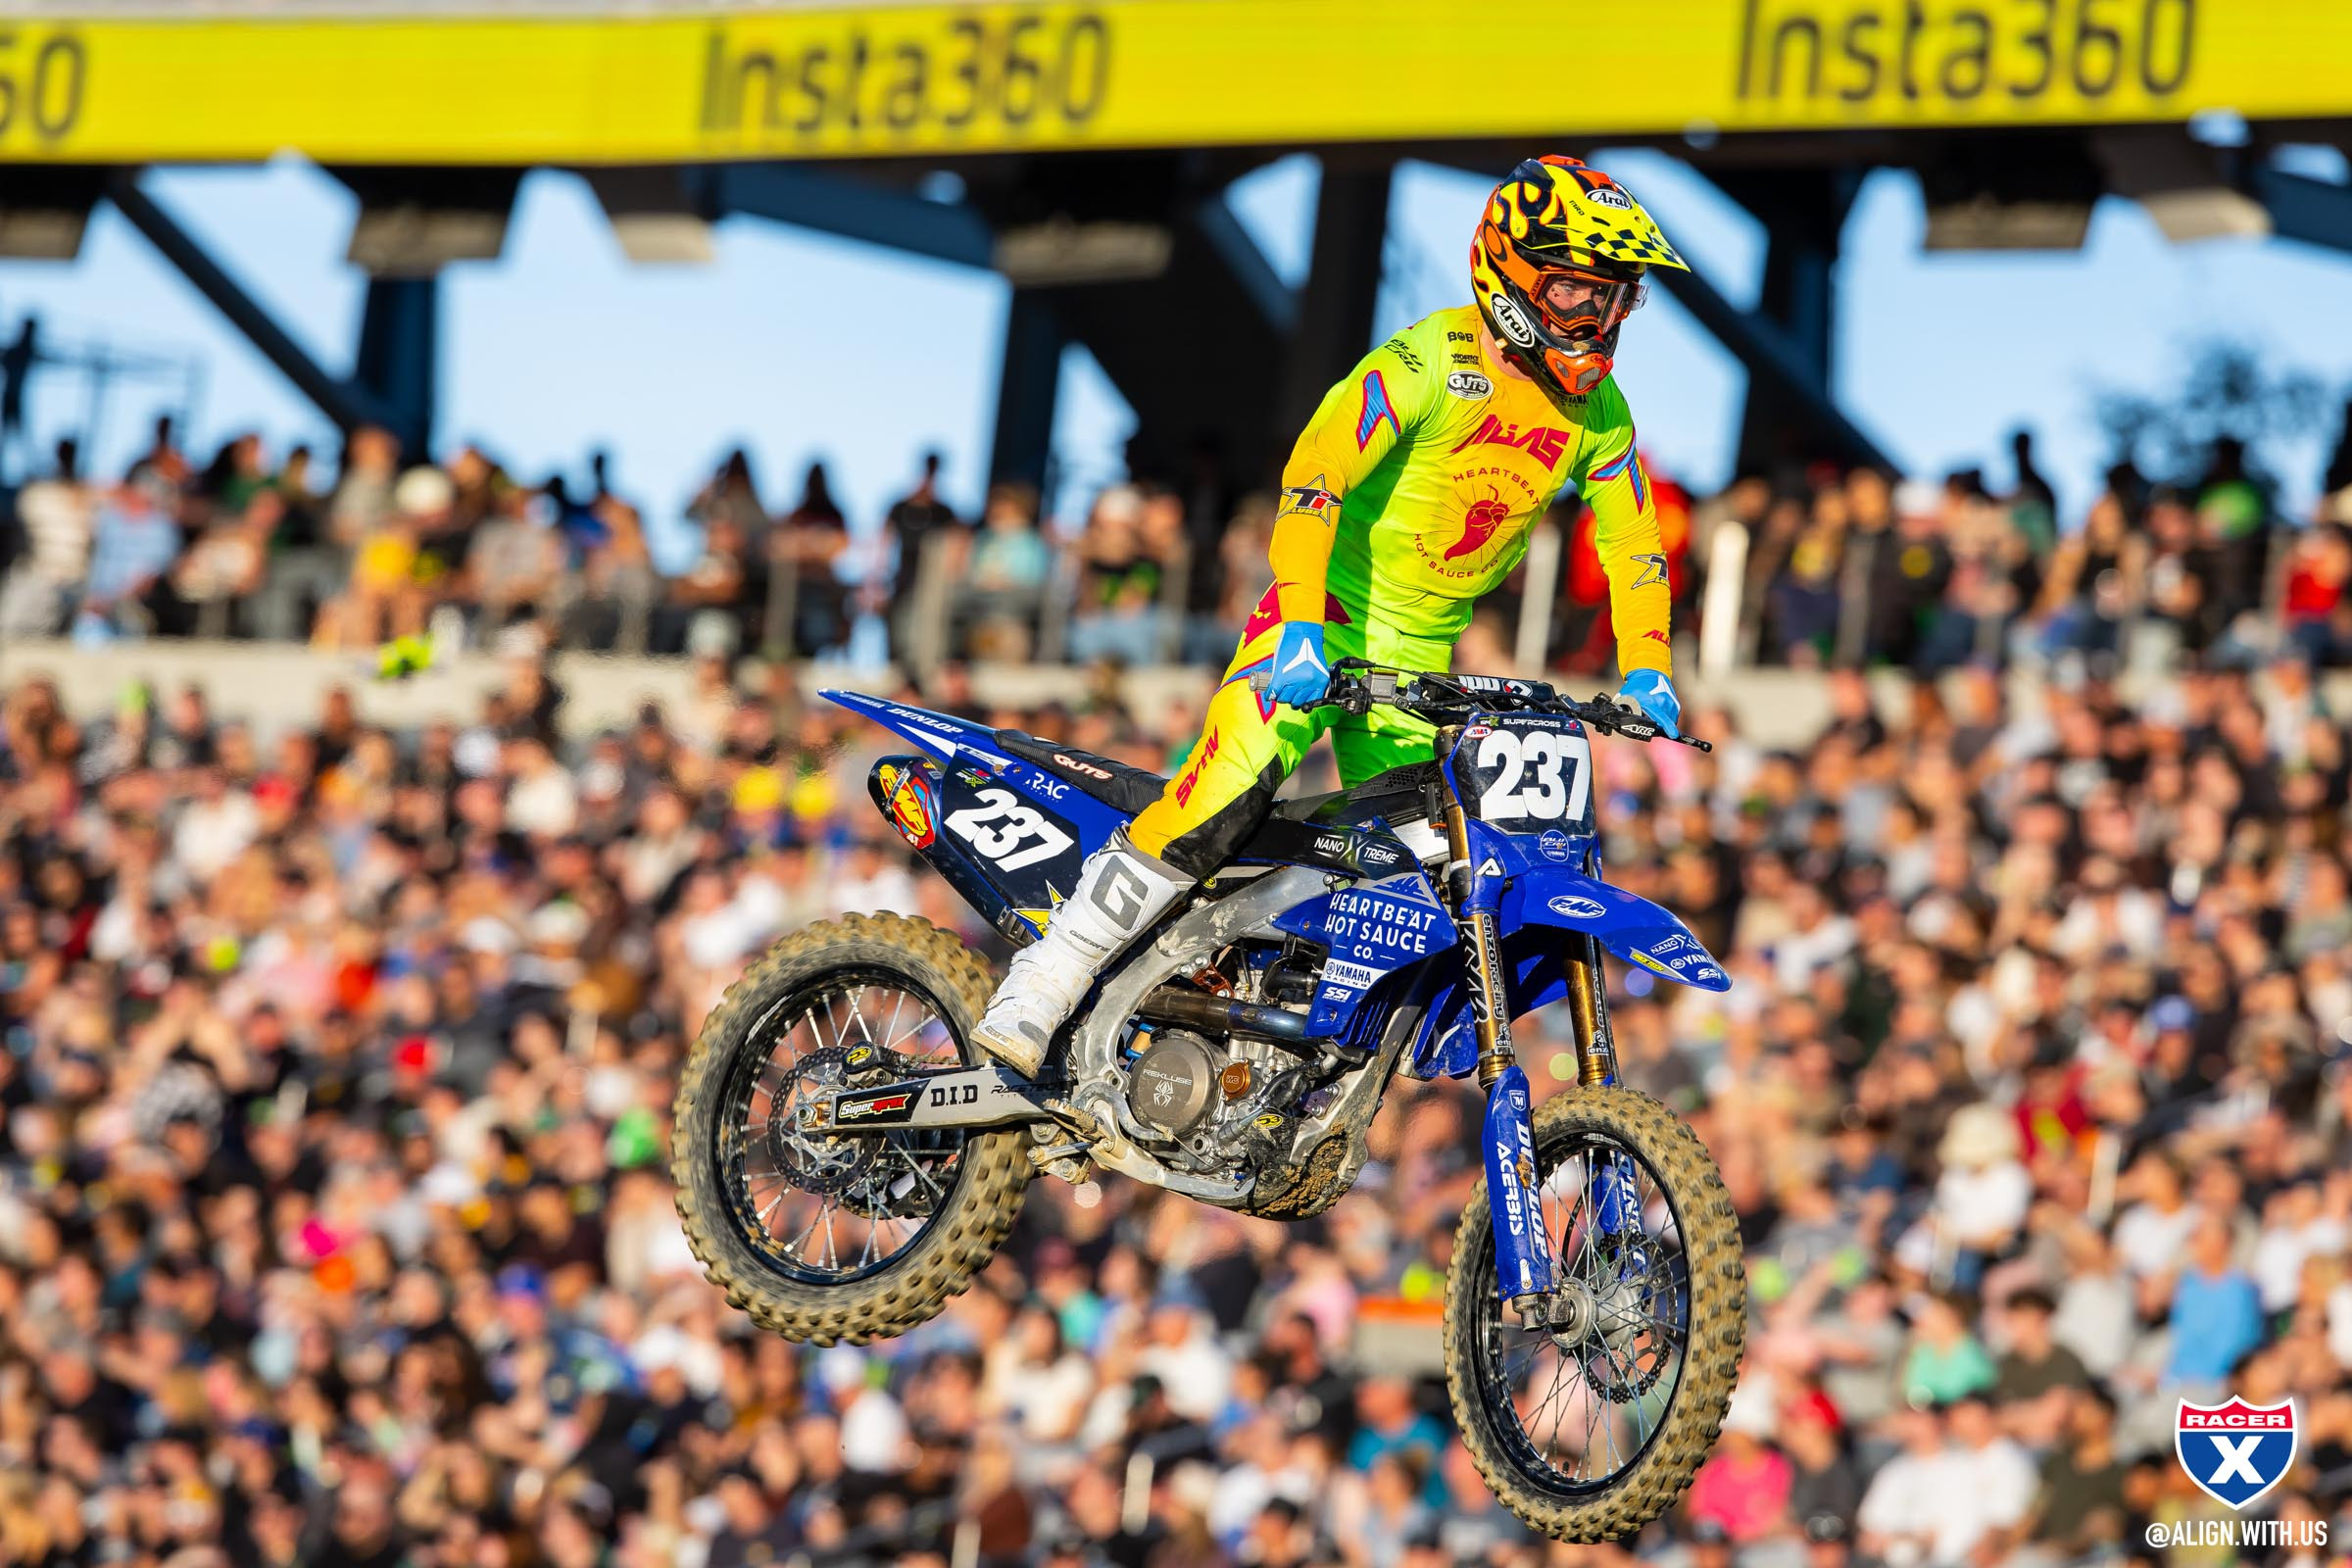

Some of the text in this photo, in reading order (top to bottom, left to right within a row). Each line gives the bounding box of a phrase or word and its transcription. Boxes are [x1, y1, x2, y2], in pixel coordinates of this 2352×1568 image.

[1736, 0, 2197, 101] Insta360
[699, 14, 1110, 131] Insta360
[1594, 192, 1629, 208] Arai
[1493, 300, 1530, 339] Arai
[1449, 374, 1489, 390] GUTS
[1452, 467, 1540, 506] HEARTBEAT
[1414, 533, 1429, 558] HOT
[1428, 561, 1475, 578] SAUCE
[886, 708, 964, 735] DUNLOP
[1502, 717, 1562, 728] SUPERCROSS
[1620, 724, 1655, 737] ARC
[1053, 754, 1114, 781] GUTS
[1477, 729, 1592, 821] 237
[943, 787, 1075, 873] 237
[1314, 836, 1346, 853] NANO
[1363, 846, 1399, 864] TREME
[1329, 892, 1437, 932] HEARTBEAT
[1549, 898, 1604, 916] FMF
[1324, 913, 1428, 955] HOT SAUCE
[1353, 943, 1375, 961] CO.
[1649, 939, 1679, 955] NANO
[1335, 963, 1372, 984] YAMAHA
[1323, 986, 1352, 1002] SSI
[1143, 1069, 1193, 1086] REKLUSE
[841, 1095, 906, 1116] Supersprox
[930, 1084, 978, 1107] D.I.D
